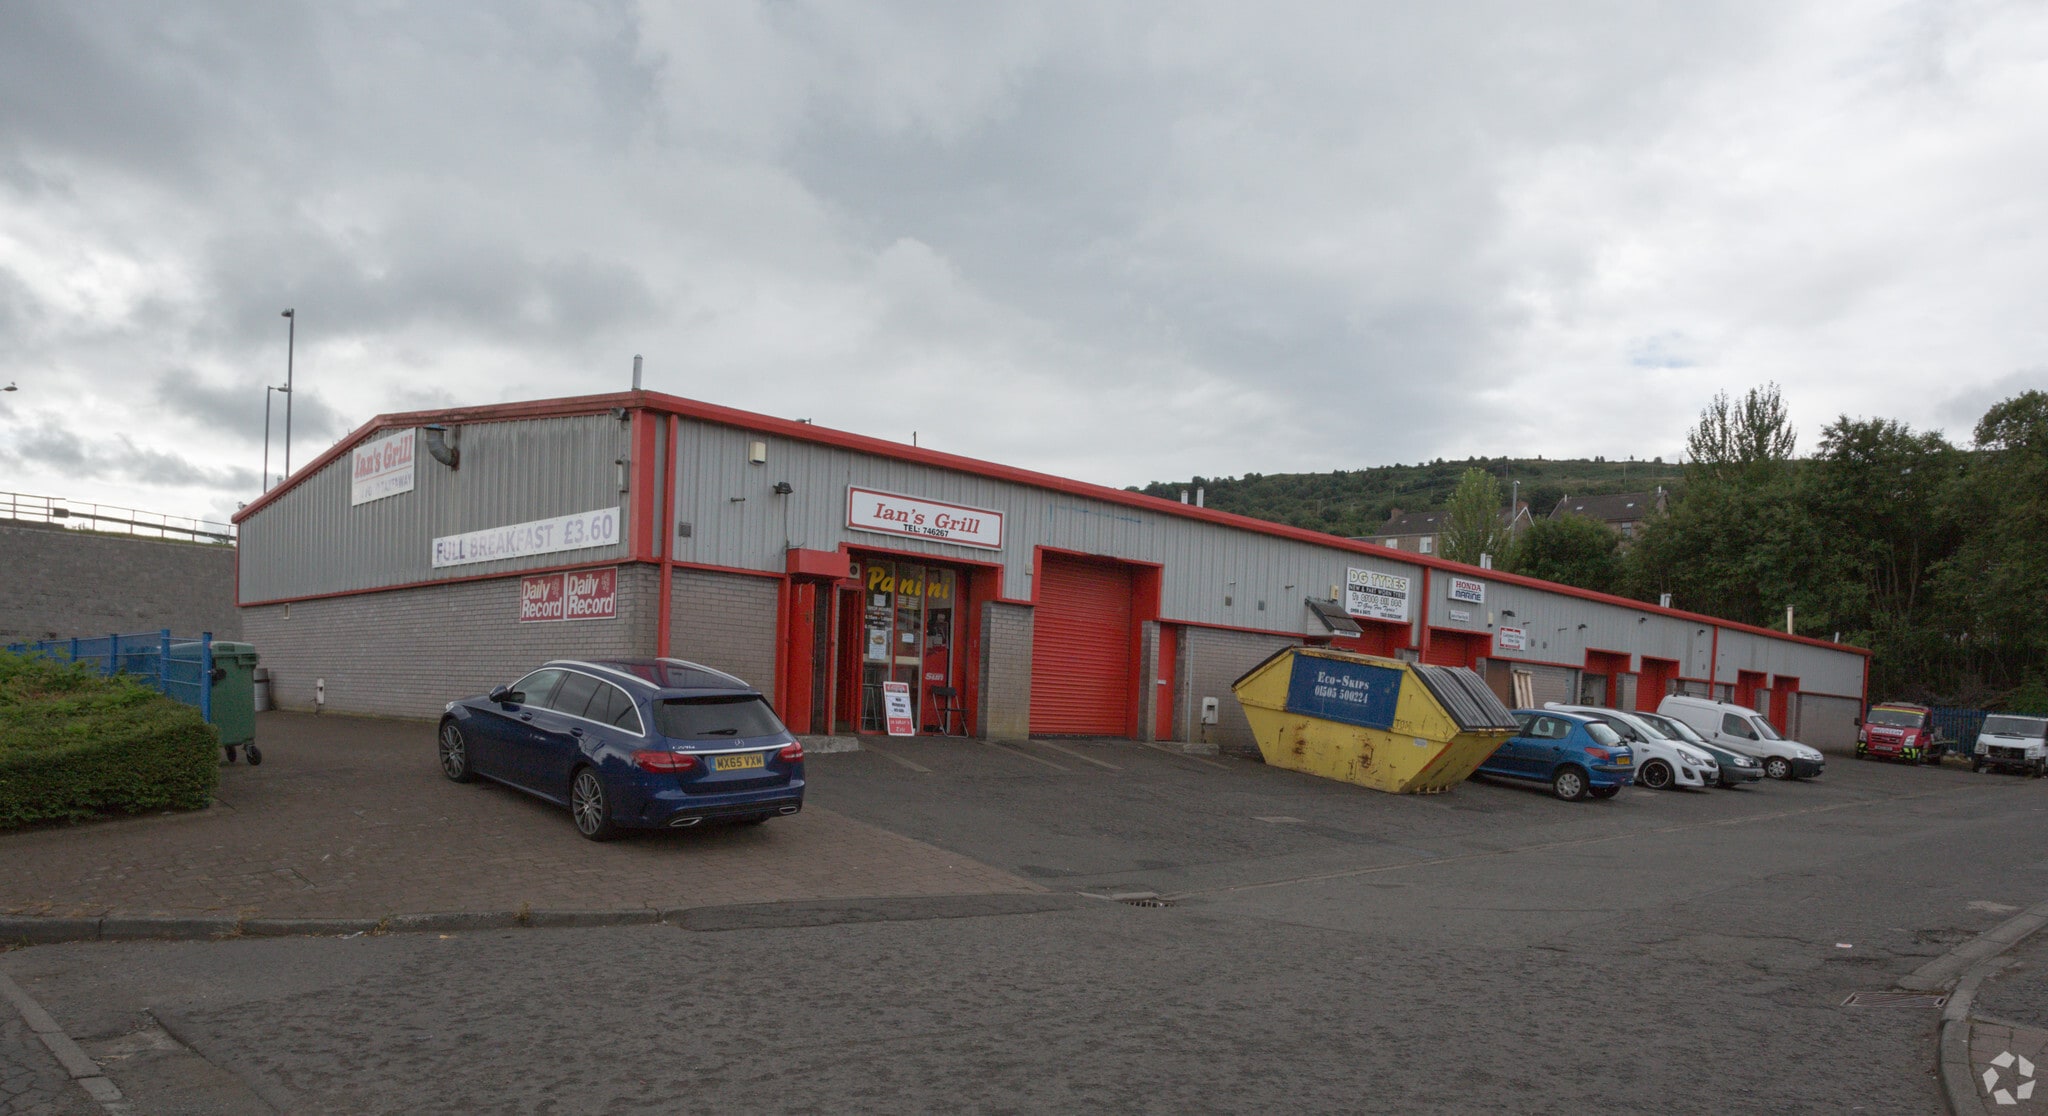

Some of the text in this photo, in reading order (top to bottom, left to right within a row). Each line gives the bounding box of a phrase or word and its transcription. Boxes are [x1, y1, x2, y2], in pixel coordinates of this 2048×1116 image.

[354, 434, 413, 478] Ian's Grill
[873, 502, 981, 535] Ian's Grill
[436, 514, 613, 562] FULL BREAKFAST £3.60
[903, 523, 949, 537] TEL: 746267
[522, 579, 551, 601] Daily
[568, 573, 600, 596] Daily
[867, 566, 951, 599] Panini
[1349, 569, 1407, 591] DG TYRES
[1455, 580, 1482, 592] HONDA
[568, 592, 615, 615] Record
[1455, 590, 1482, 601] MARINE
[521, 597, 562, 618] Record
[1314, 685, 1369, 704] 01505 500224
[716, 756, 742, 769] MX65
